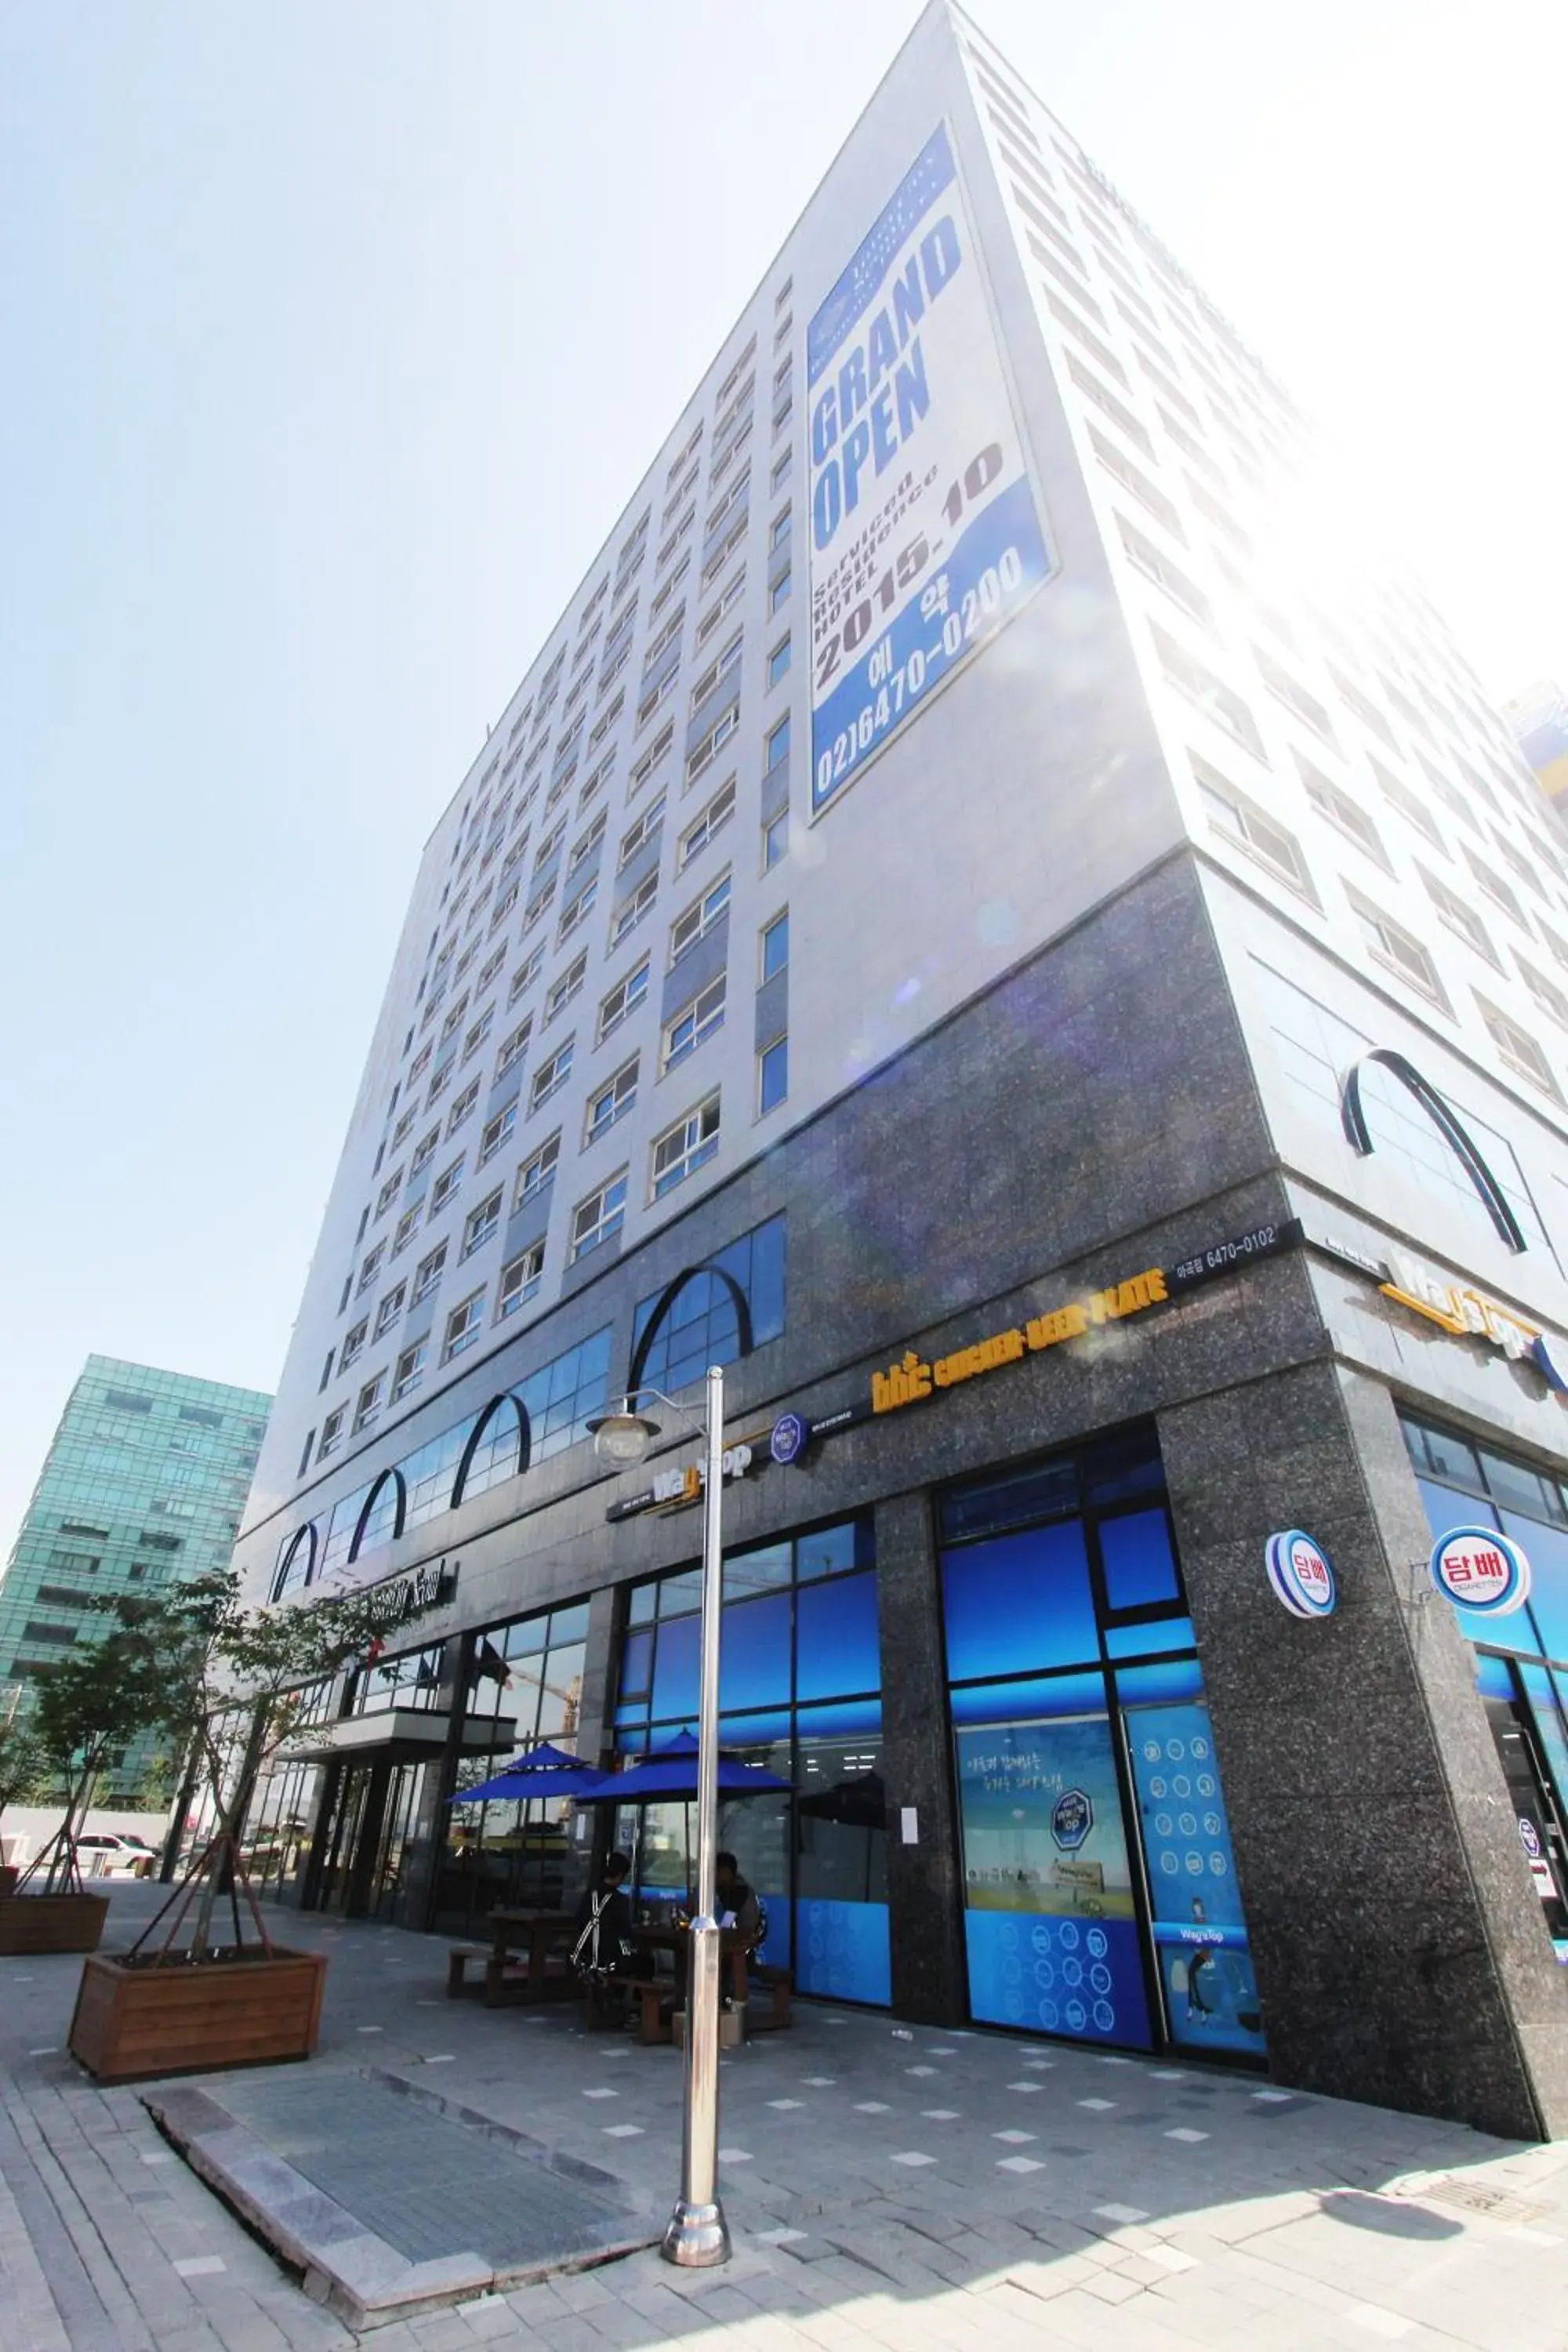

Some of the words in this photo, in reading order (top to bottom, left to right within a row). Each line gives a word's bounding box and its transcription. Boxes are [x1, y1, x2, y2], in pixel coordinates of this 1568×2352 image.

[812, 214, 963, 467] GRAND
[813, 336, 931, 552] OPEN
[814, 464, 938, 624] Residence
[815, 561, 877, 644] HOTEL
[817, 545, 1024, 794] 02)6470-0200
[1207, 1226, 1276, 1269] 6470-0102
[872, 1350, 933, 1414] bhc
[1293, 1553, 1327, 1584] 담배
[1443, 1551, 1503, 1584] 담배
